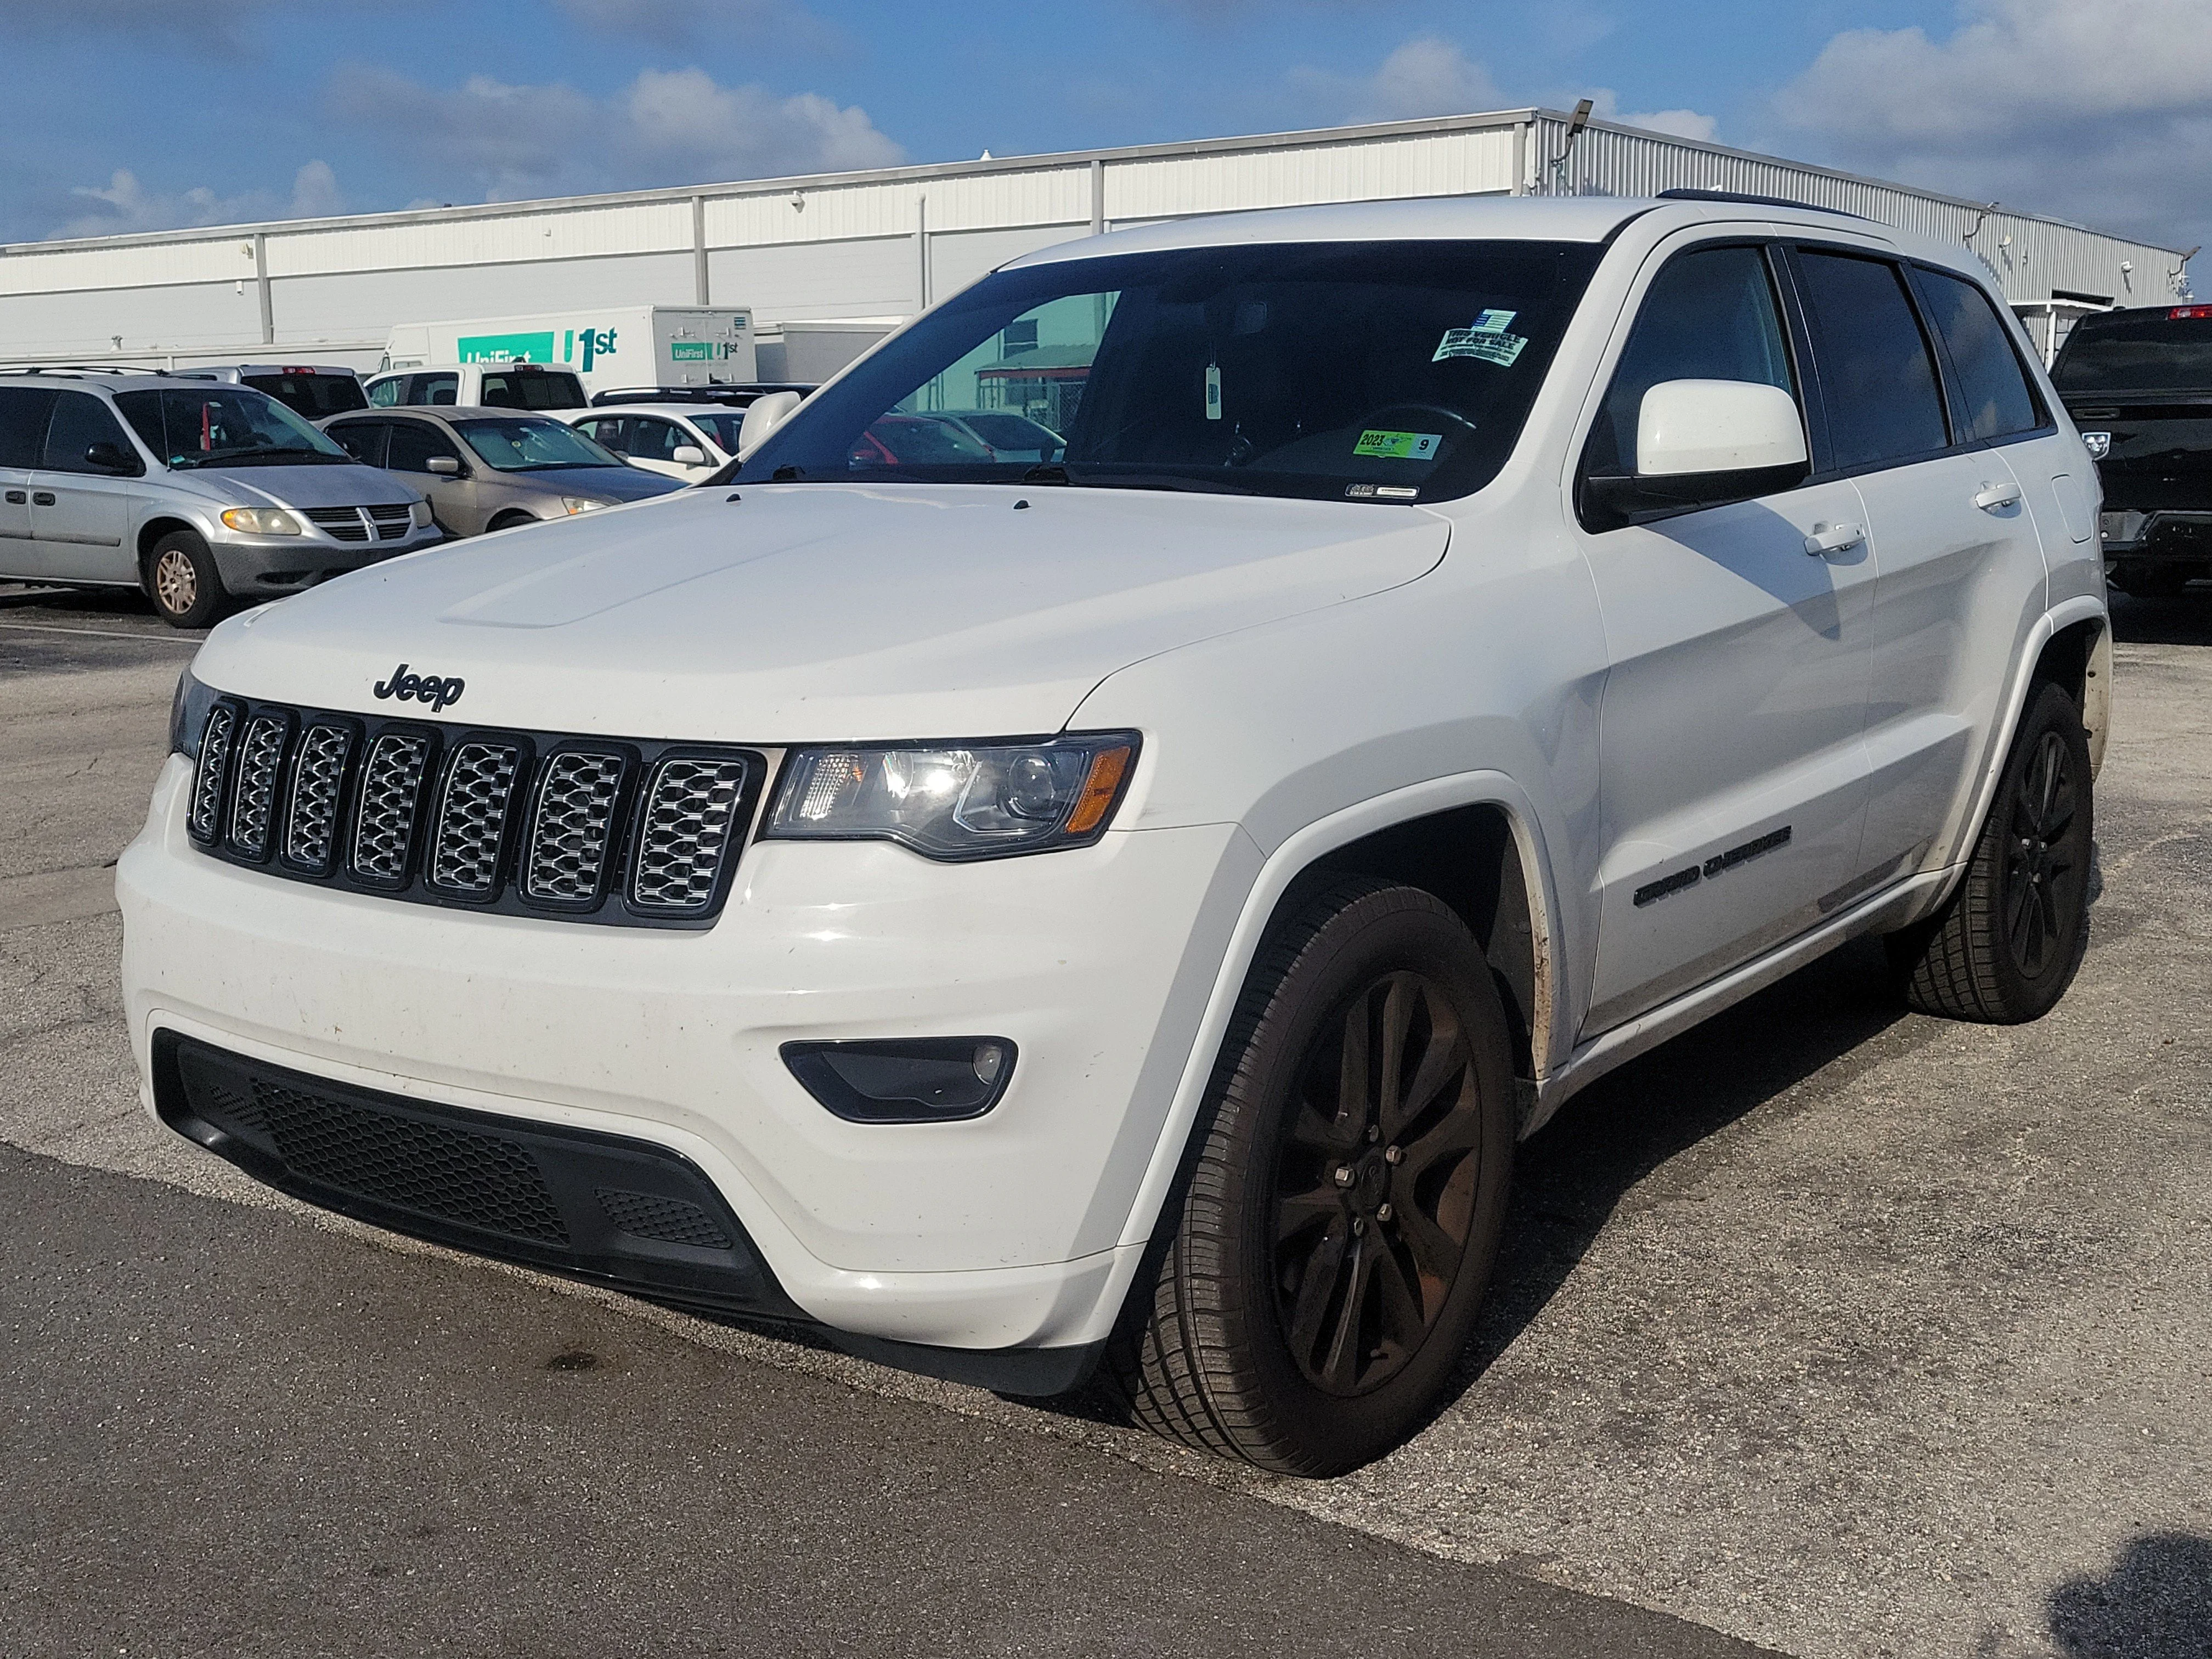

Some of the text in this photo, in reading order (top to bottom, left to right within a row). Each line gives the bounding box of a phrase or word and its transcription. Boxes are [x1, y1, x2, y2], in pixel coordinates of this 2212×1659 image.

[1489, 340, 1516, 350] SALE
[675, 349, 703, 358] UniFirst
[1360, 433, 1430, 451] 2023 9
[373, 663, 466, 713] Jeep
